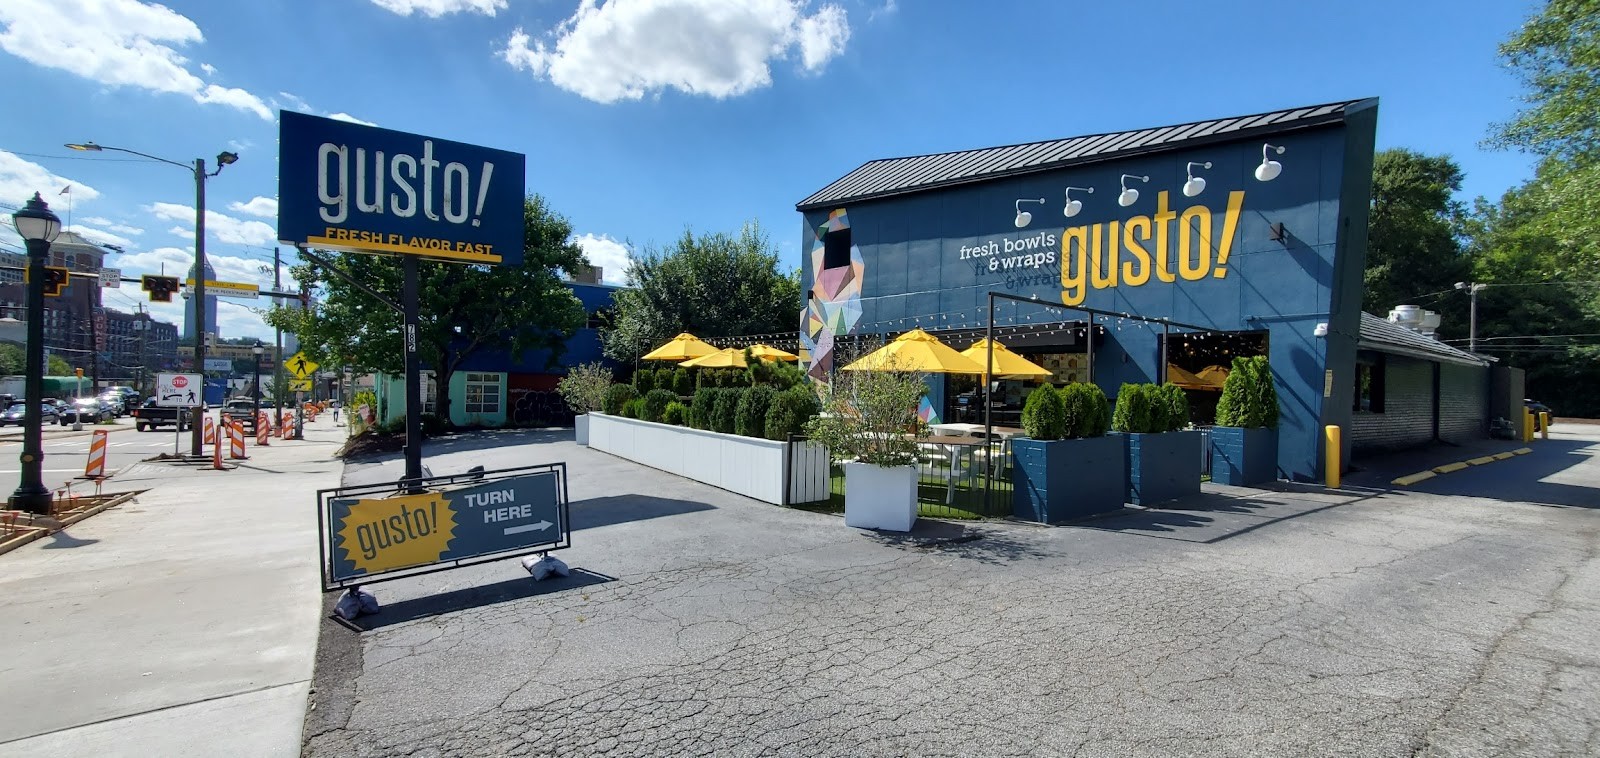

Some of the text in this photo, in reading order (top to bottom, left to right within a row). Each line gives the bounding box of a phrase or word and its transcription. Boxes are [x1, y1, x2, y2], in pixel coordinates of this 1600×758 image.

[318, 139, 494, 227] gusto!
[325, 227, 493, 255] FRESH FLAVOR FAST
[960, 231, 1056, 260] fresh bowls
[1061, 190, 1245, 306] gusto!
[1001, 248, 1056, 270] wraps
[464, 489, 515, 508] TURN
[484, 504, 532, 524] HERE
[356, 501, 438, 561] gusto!
